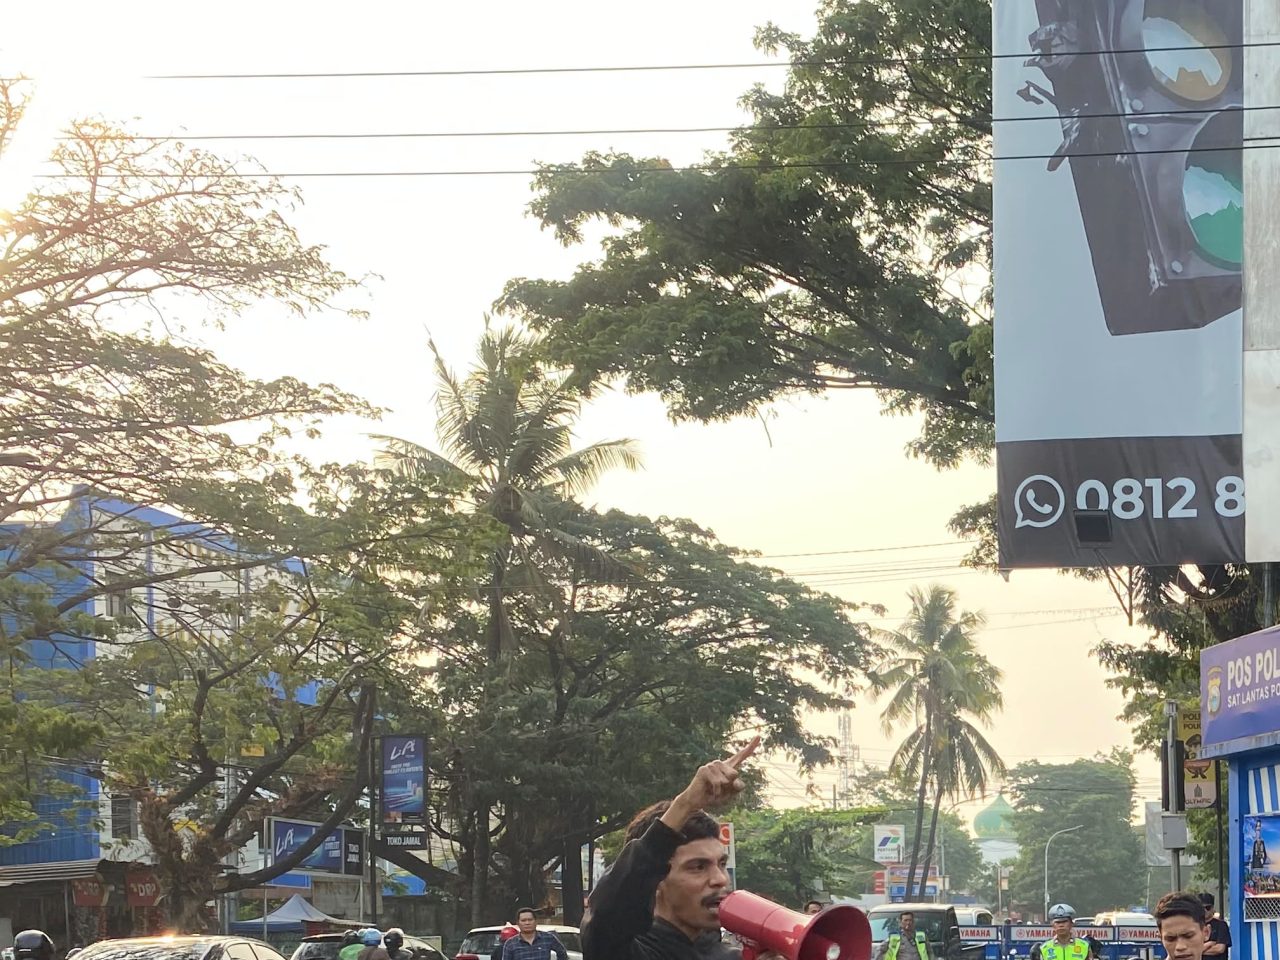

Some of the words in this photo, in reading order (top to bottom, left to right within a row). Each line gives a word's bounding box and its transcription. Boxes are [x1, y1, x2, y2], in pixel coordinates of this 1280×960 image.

[1076, 476, 1198, 520] 0812
[1214, 475, 1246, 518] 8
[1228, 655, 1252, 691] POS
[1228, 692, 1240, 708] SAT
[1241, 686, 1270, 705] LANTAS
[387, 836, 402, 845] TOKO
[402, 836, 421, 846] JAMAL
[1076, 929, 1108, 939] YAMAHA
